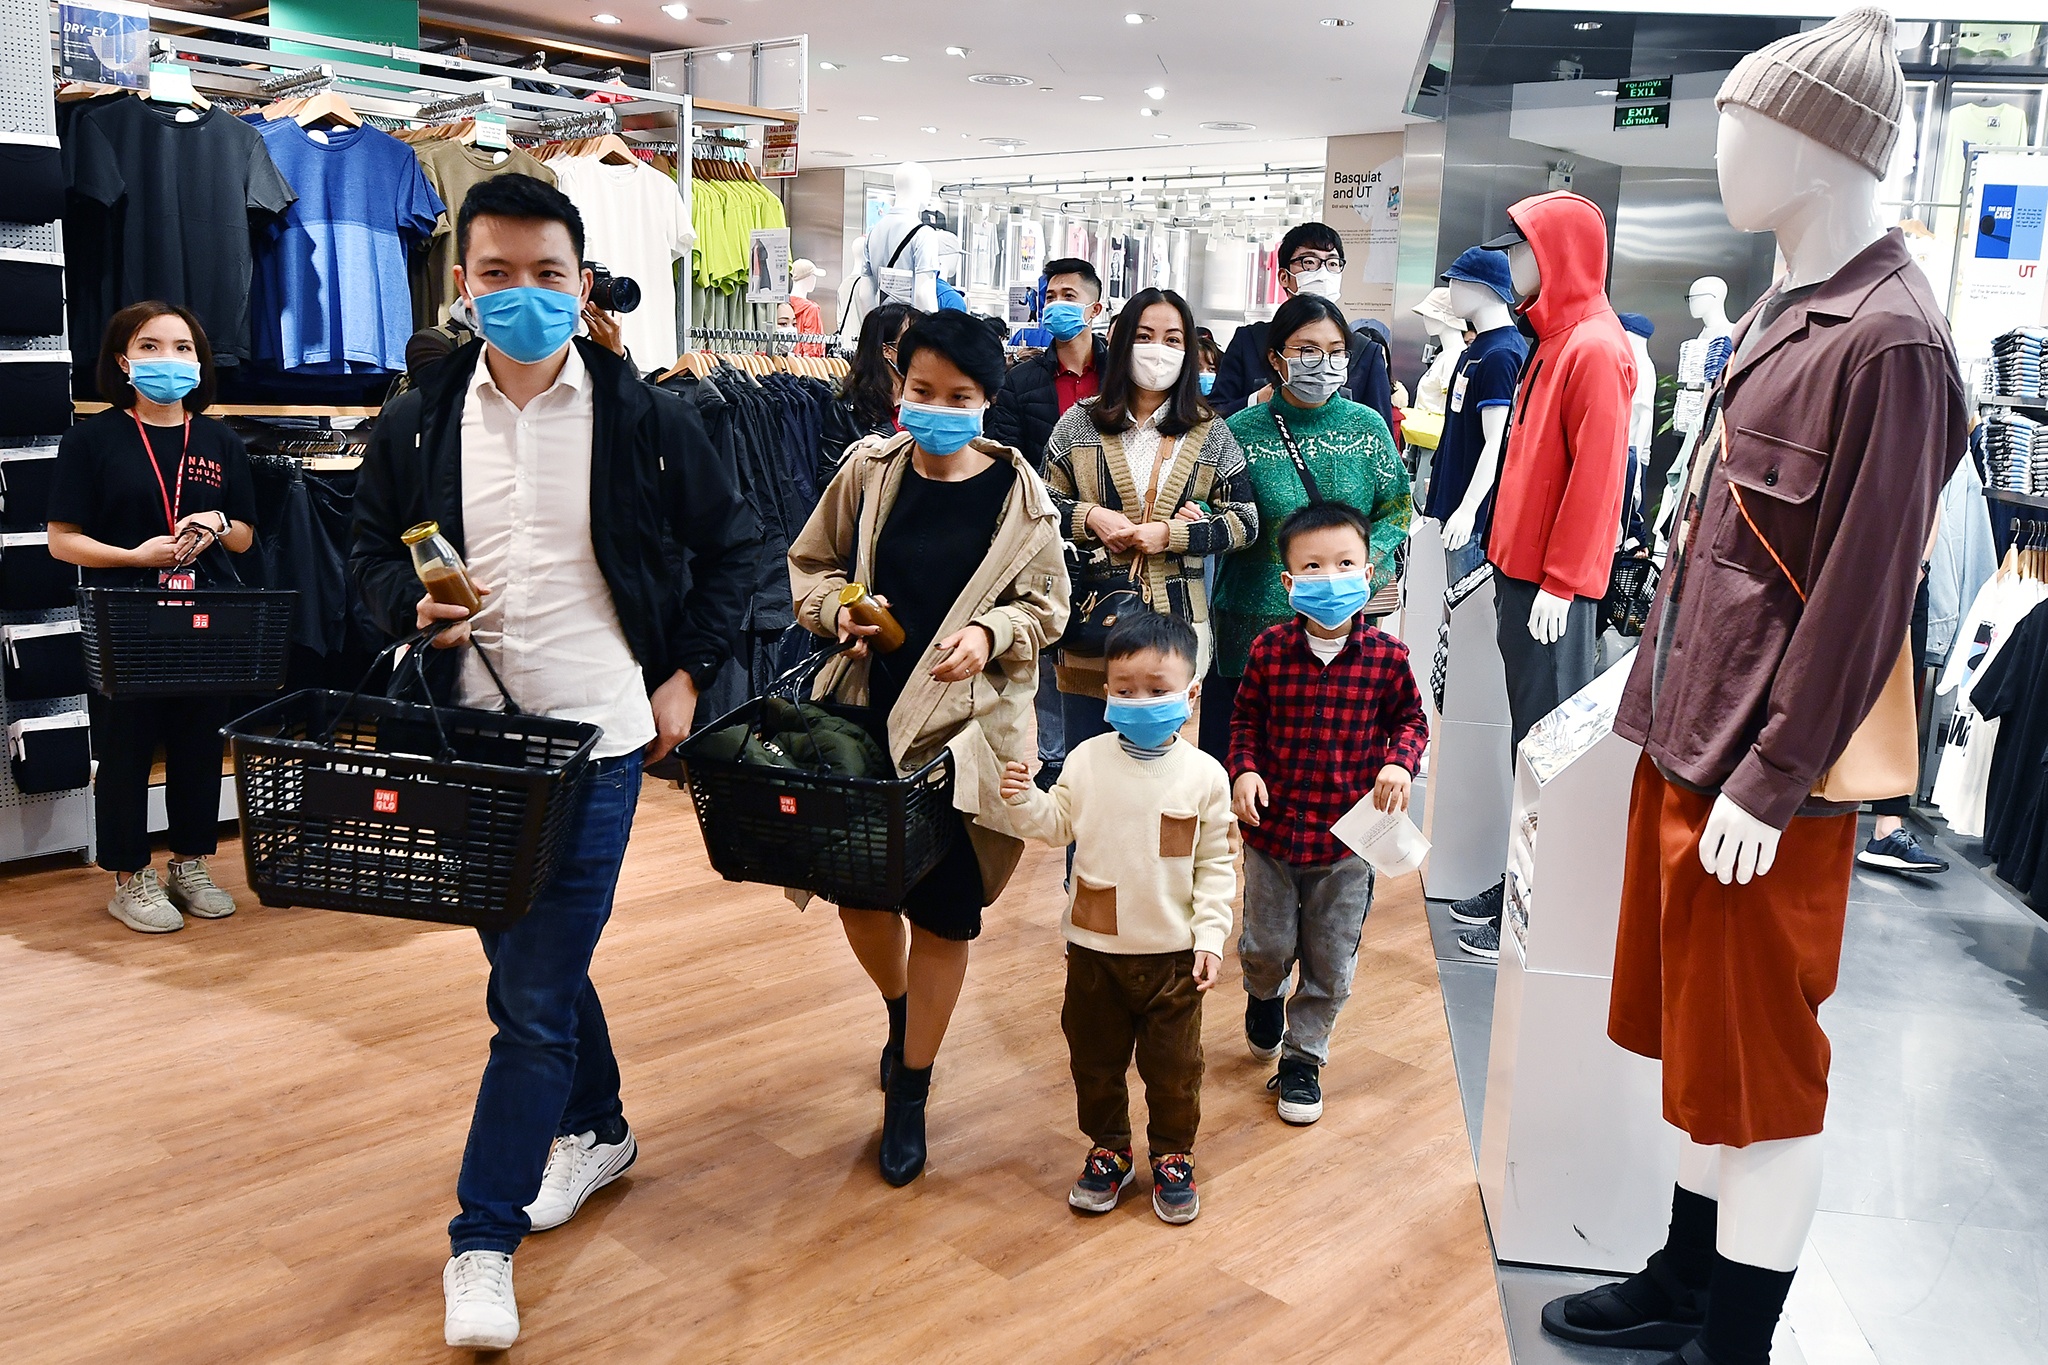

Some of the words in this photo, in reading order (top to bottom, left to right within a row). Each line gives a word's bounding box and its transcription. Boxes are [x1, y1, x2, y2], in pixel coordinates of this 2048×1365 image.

[63, 22, 107, 37] DRY-EX
[1628, 107, 1655, 117] EXIT
[1334, 171, 1382, 185] Basquiat
[1333, 187, 1354, 199] and
[1357, 186, 1372, 198] UT
[1994, 211, 2012, 219] CARS
[2018, 265, 2037, 278] UT
[376, 792, 395, 801] UNI
[376, 801, 395, 811] QLO
